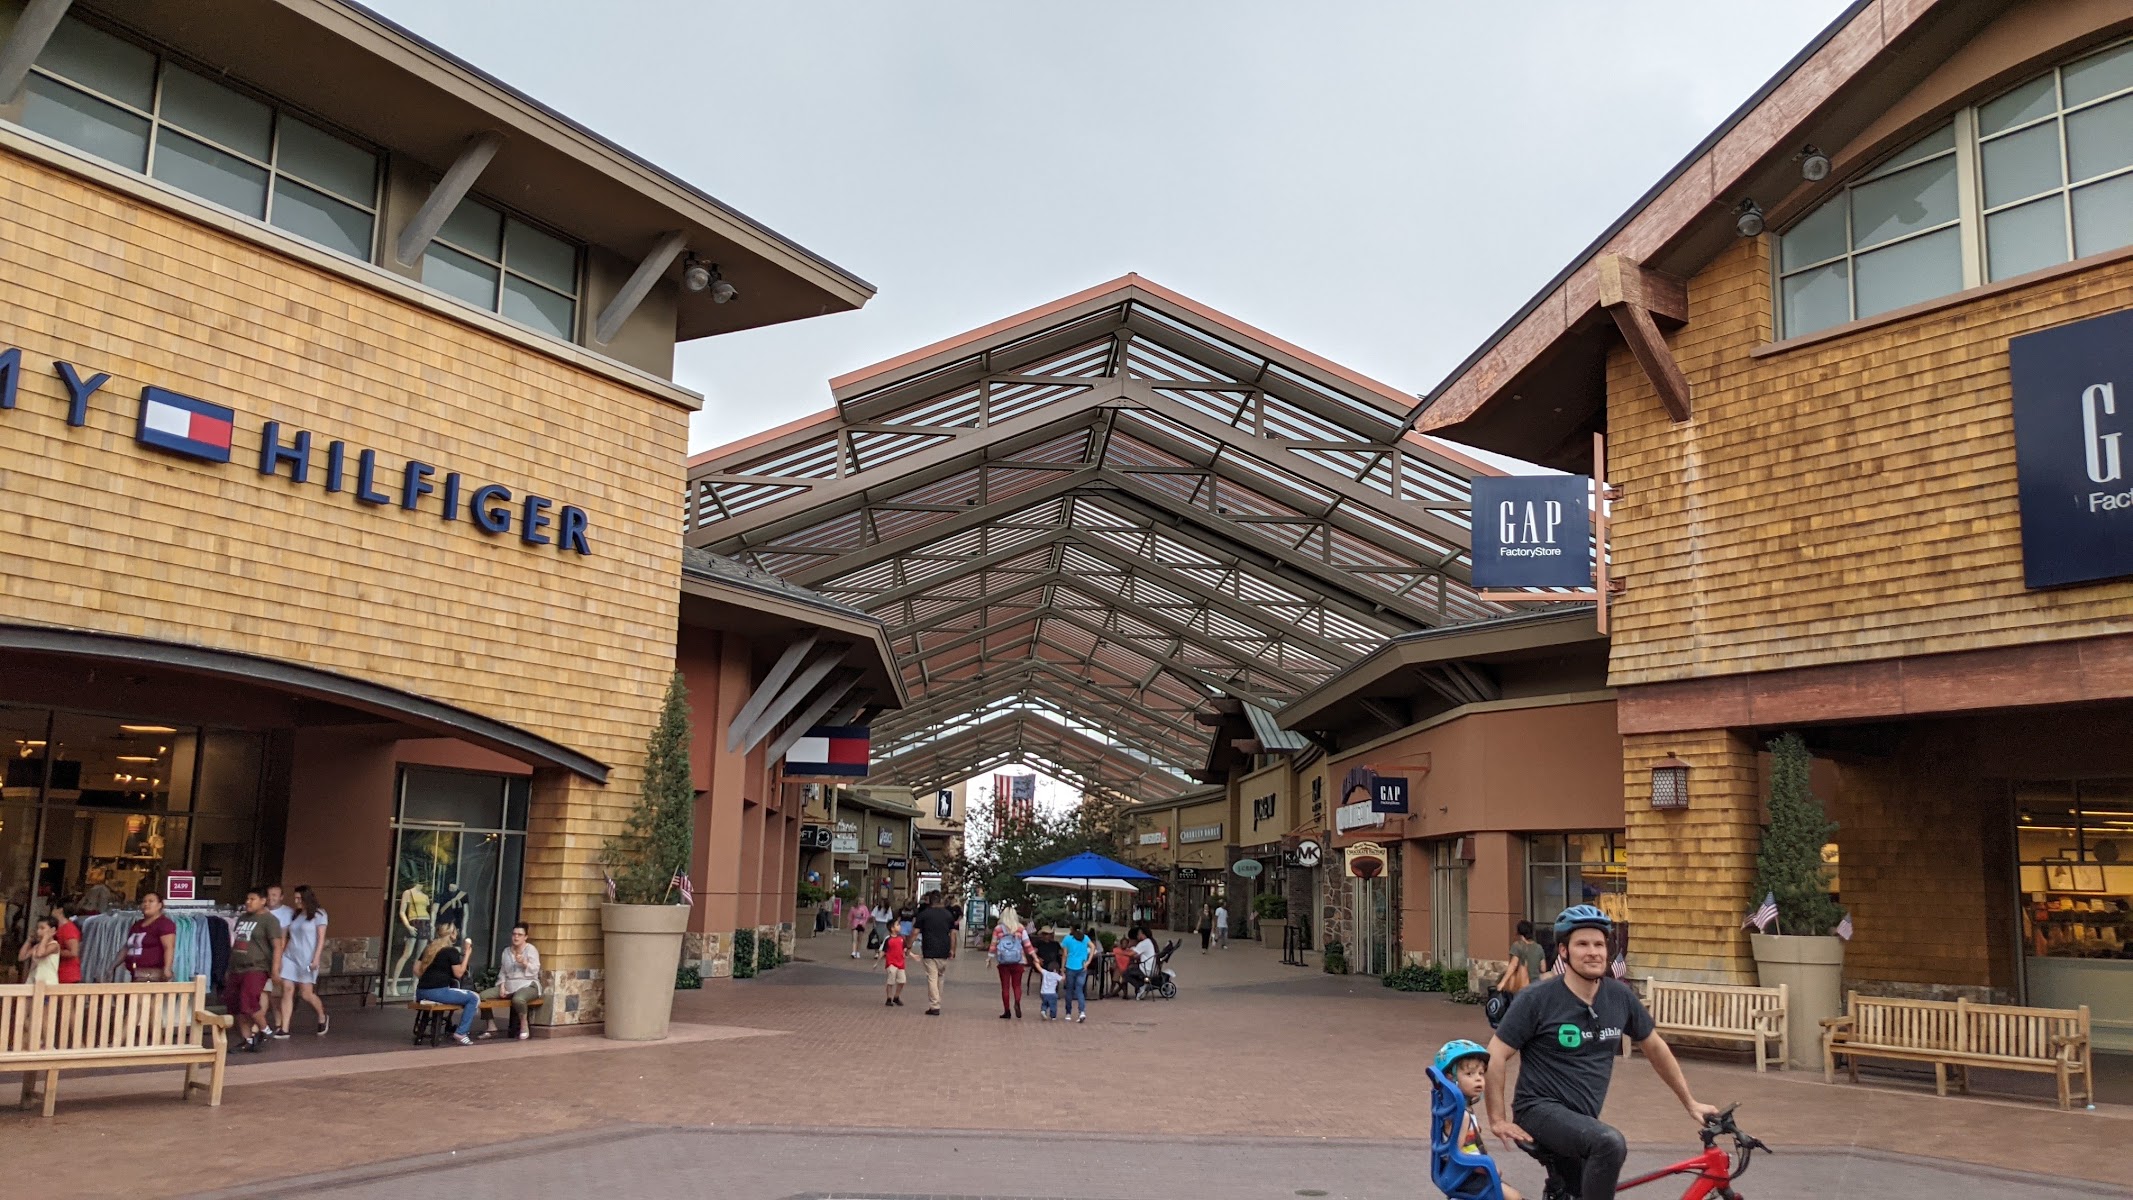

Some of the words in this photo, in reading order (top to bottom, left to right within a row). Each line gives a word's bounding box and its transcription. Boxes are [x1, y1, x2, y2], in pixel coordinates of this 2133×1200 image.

[2082, 382, 2122, 482] G
[259, 420, 592, 556] HILFIGER
[1500, 500, 1561, 544] GAP
[1500, 547, 1561, 557] FactoryStore
[1380, 785, 1400, 800] GAP
[800, 830, 813, 839] FT
[1300, 846, 1319, 860] MK
[1581, 1026, 1621, 1040] tagible
